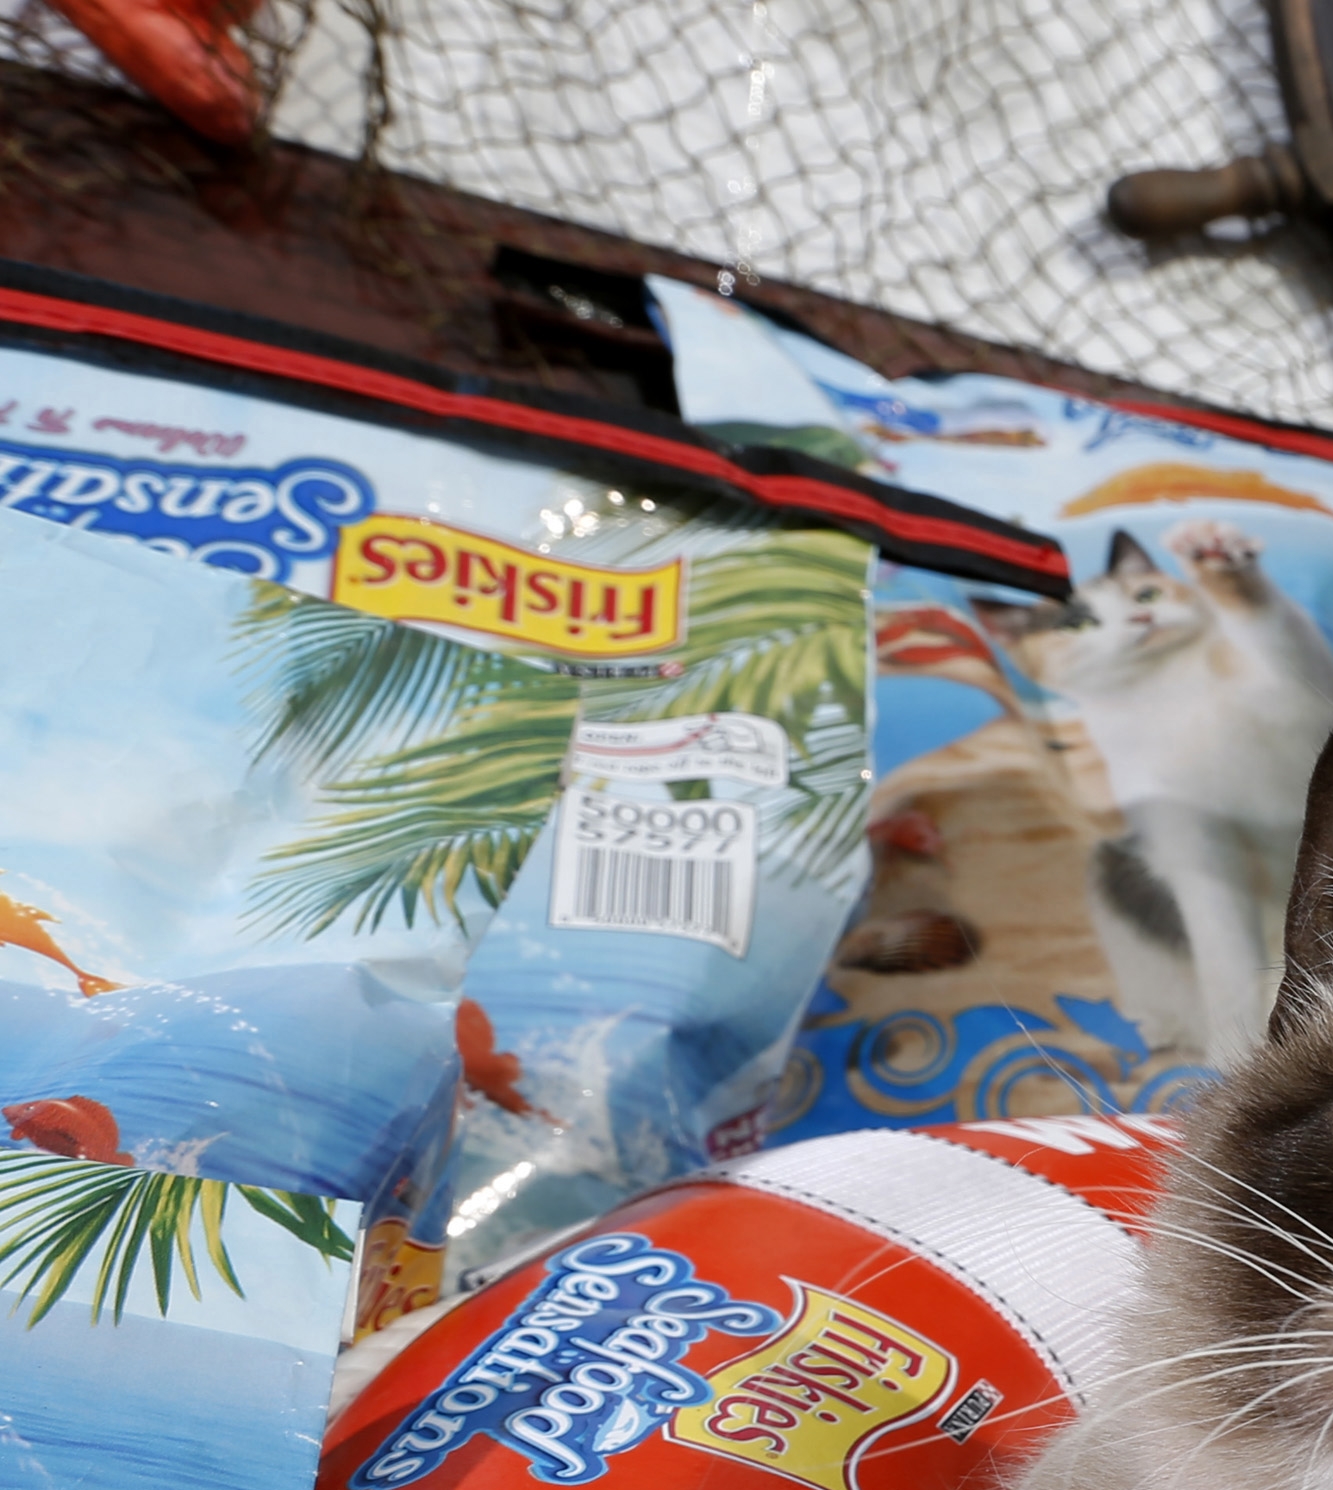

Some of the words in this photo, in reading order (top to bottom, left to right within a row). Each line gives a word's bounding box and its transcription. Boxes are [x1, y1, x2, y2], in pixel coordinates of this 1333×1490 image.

[349, 531, 661, 642] Friskies
[366, 1238, 675, 1484] Sensations
[512, 1284, 780, 1481] Seafood
[710, 1308, 925, 1456] Friskies
